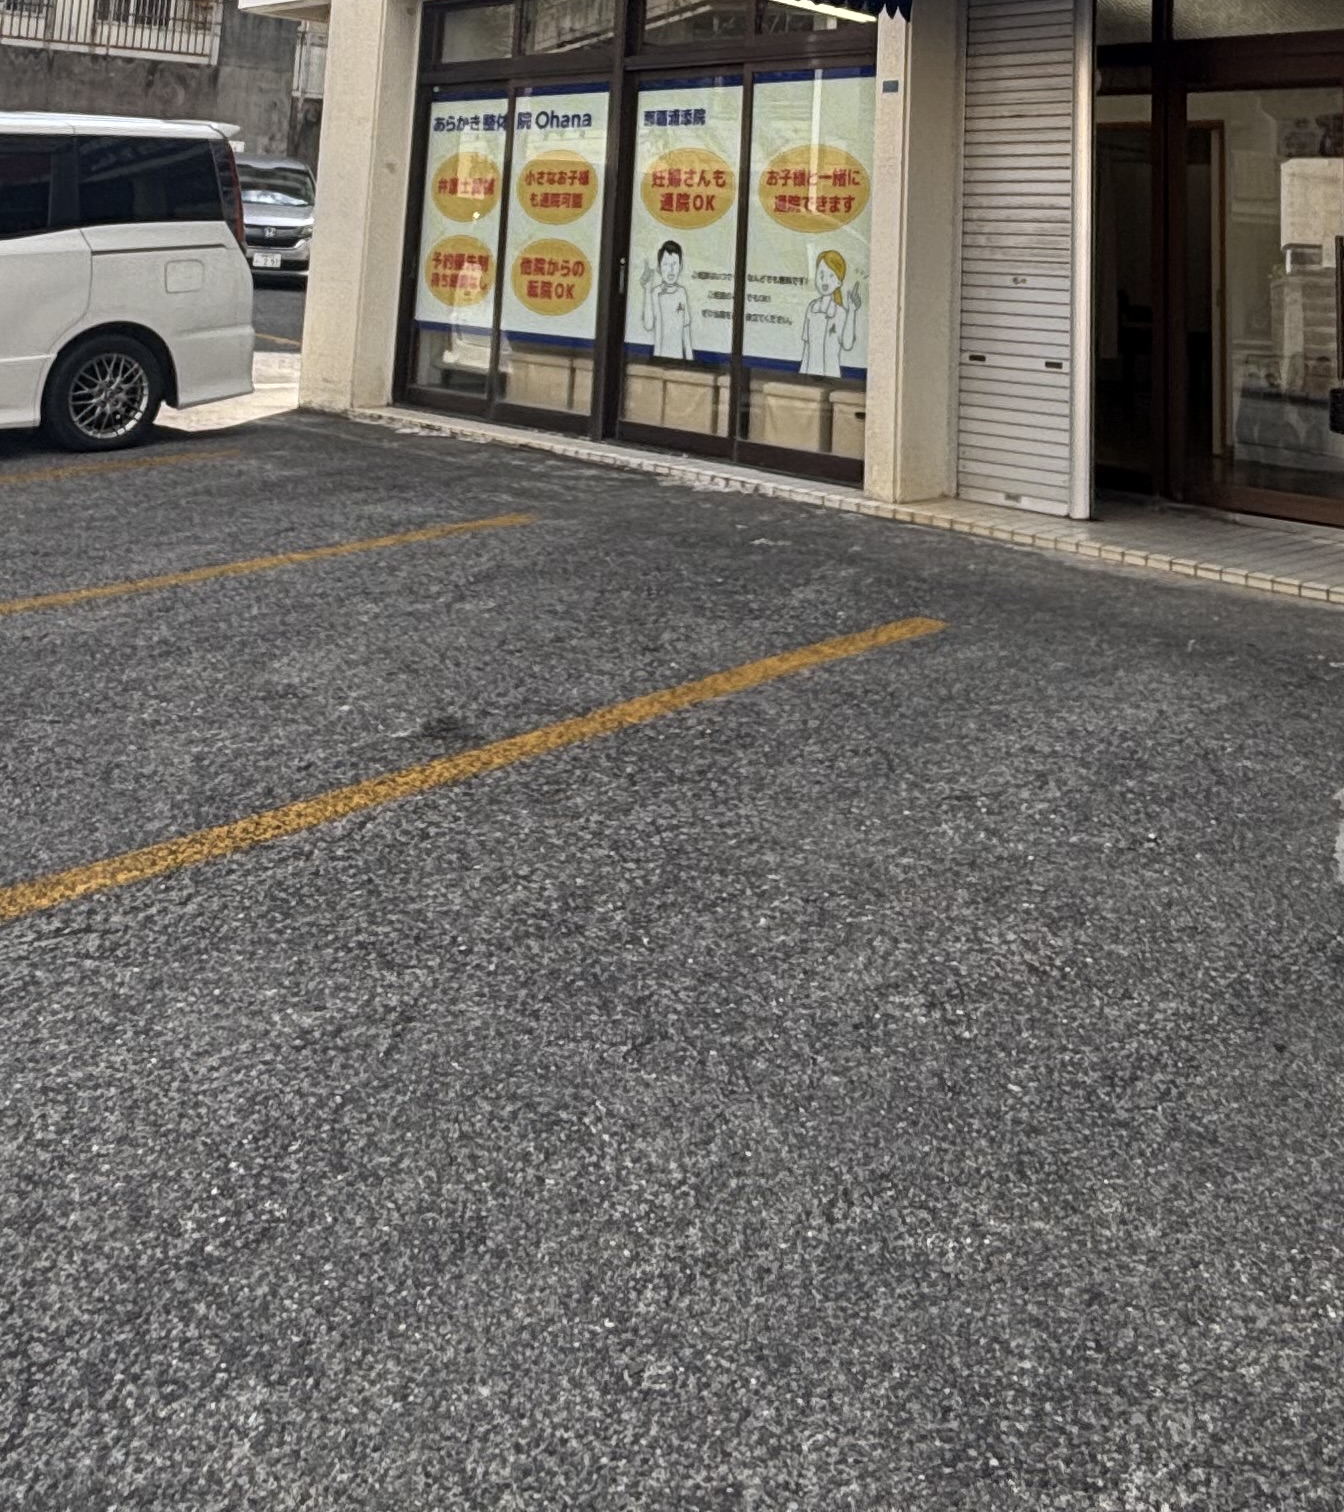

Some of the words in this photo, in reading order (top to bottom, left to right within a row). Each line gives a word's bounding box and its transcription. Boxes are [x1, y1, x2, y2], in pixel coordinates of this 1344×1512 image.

[535, 111, 592, 130] Ohana
[525, 170, 590, 185] 小さなお子様
[651, 169, 726, 188] 妊婦さんも
[766, 169, 861, 187] お子様と一緒に
[774, 194, 856, 213] 通院できます
[520, 257, 585, 277] 他院からの
